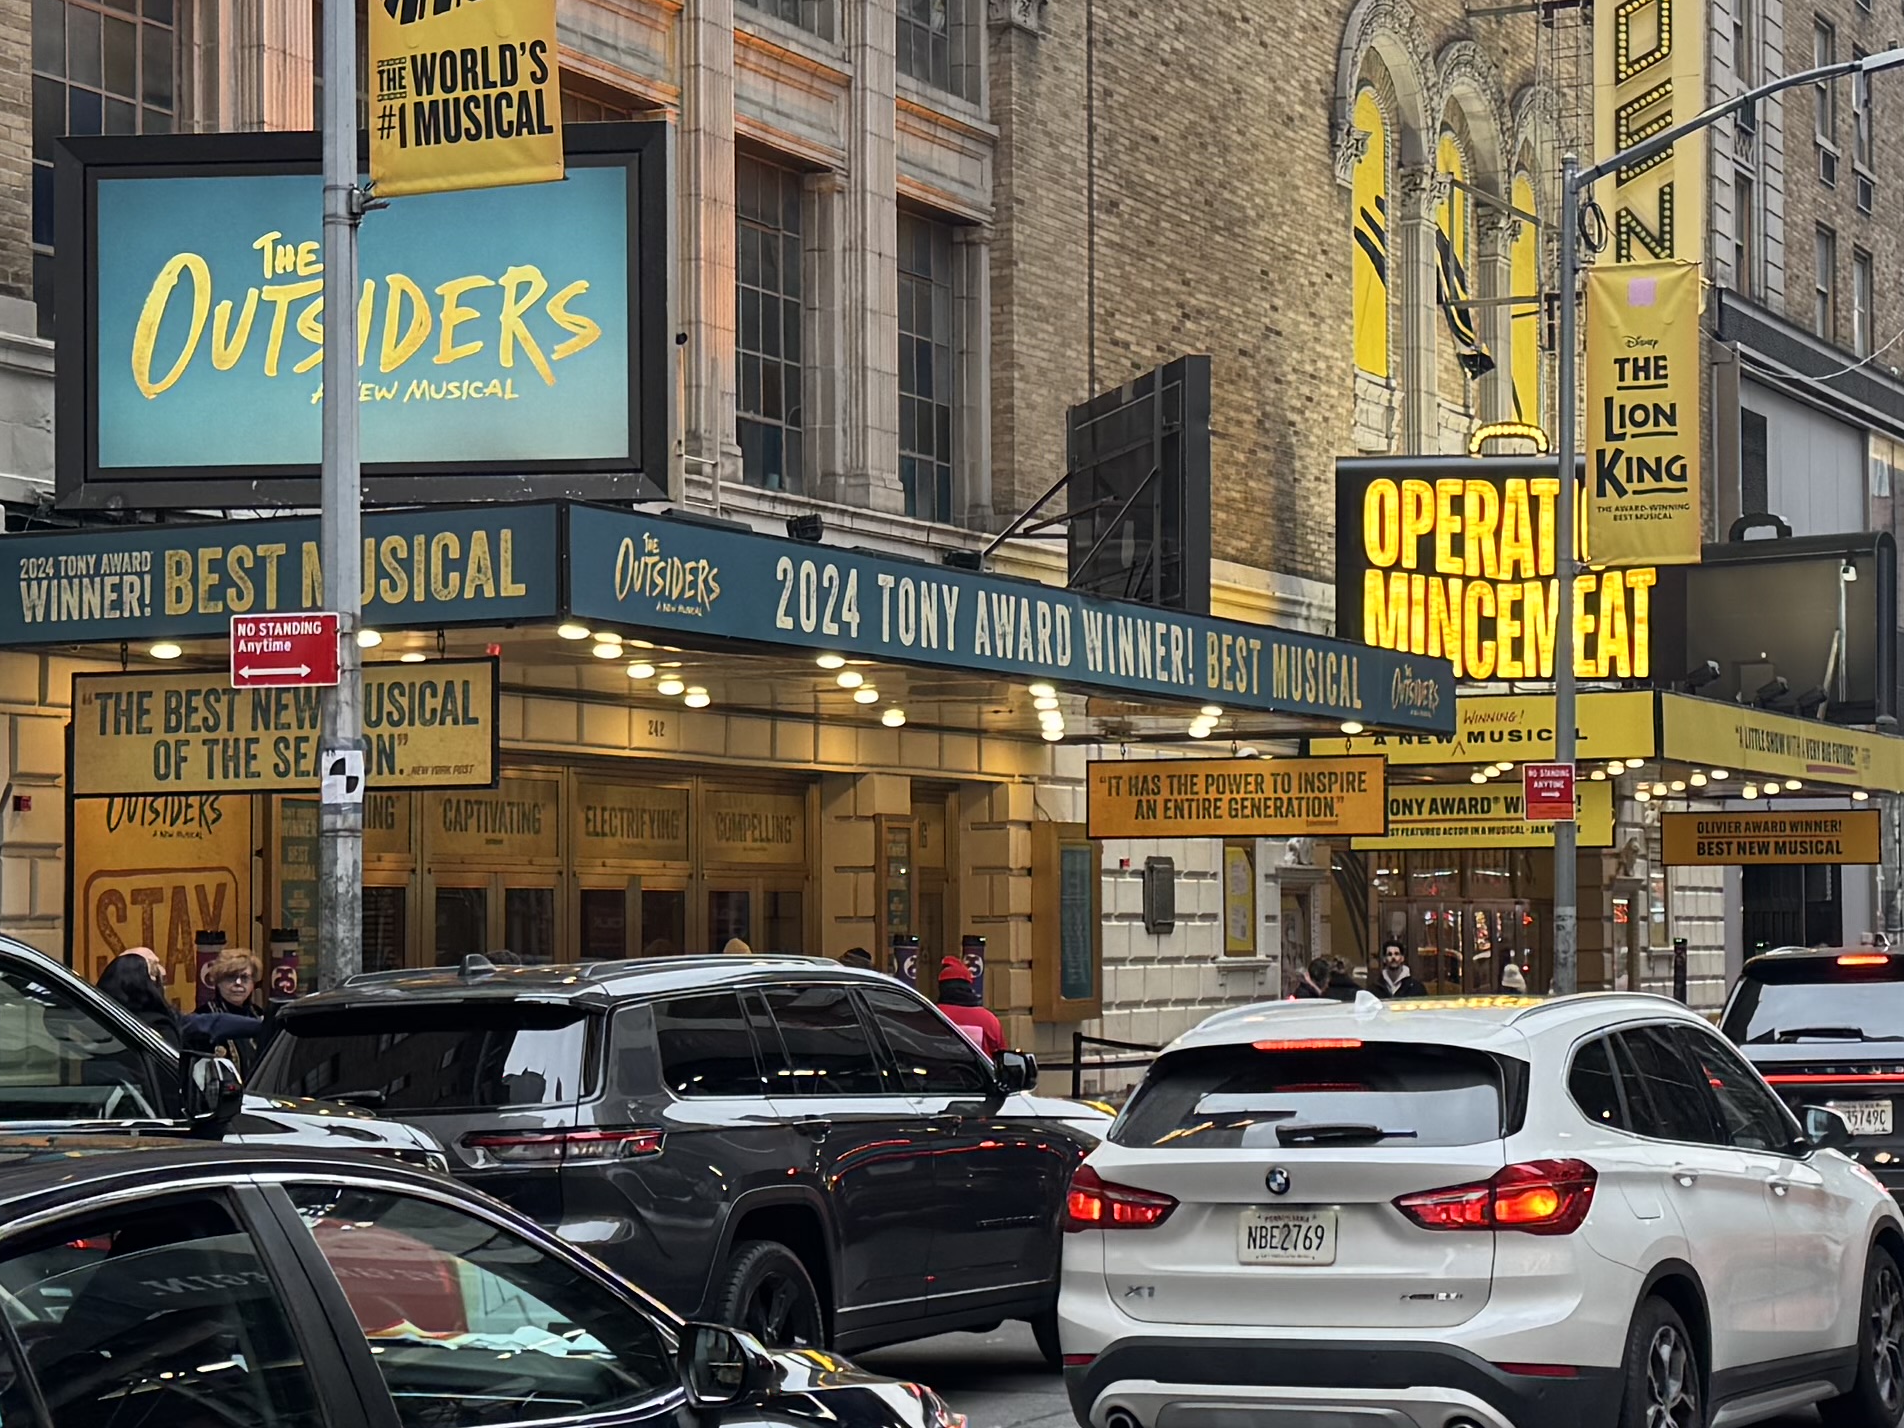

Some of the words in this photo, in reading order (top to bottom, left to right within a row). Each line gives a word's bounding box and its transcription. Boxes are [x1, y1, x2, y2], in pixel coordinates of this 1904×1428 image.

[377, 69, 407, 96] THE
[410, 39, 549, 97] WORLD’S
[377, 104, 408, 149] #1
[414, 88, 554, 147] MUSICAL
[253, 231, 324, 279] THE
[1613, 355, 1669, 383] THE
[357, 380, 398, 403] EW
[404, 378, 520, 404] MUSICAL
[1604, 396, 1678, 442] LION
[1596, 448, 1689, 499] KING
[1597, 505, 1613, 514] THE
[1614, 502, 1691, 513] AWARD-WINNING
[1613, 513, 1633, 522] BEST
[1634, 511, 1673, 522] MUSICAL
[643, 532, 660, 554] THE
[19, 556, 54, 580] 2024
[58, 554, 97, 577] TONY
[164, 542, 287, 616] BEST
[615, 537, 721, 612] OUTSIDERS
[20, 574, 152, 623] WINNER!
[237, 622, 257, 637] NO
[259, 621, 323, 636] STANDING
[775, 555, 861, 639] 2024
[877, 573, 958, 651] TONY
[1083, 608, 1195, 685] WINNER!
[1206, 630, 1263, 694] BEST
[1272, 643, 1363, 710] MUSICAL
[238, 639, 292, 656] Anytime
[164, 688, 242, 734] BEST
[252, 687, 322, 731] NEW
[364, 680, 480, 730] USICAL
[1464, 709, 1525, 725] WINNING!
[1467, 728, 1589, 744] MUSICL
[1746, 726, 1765, 753] LITTLE
[1766, 730, 1786, 756] SHOW
[1805, 737, 1821, 763] VERY
[1821, 740, 1832, 764] BIG
[153, 739, 190, 782] OF
[202, 736, 262, 781] THE
[1128, 775, 1161, 797] HAS
[1166, 774, 1199, 796] THE
[1205, 772, 1265, 795] POWER
[1270, 772, 1292, 794] TO
[1298, 771, 1368, 794] INSPIRE
[1134, 798, 1158, 821] AN
[1163, 797, 1222, 820] ENTIRE
[1389, 798, 1427, 817] ONY
[1390, 826, 1400, 837] ST
[1400, 826, 1441, 837] FEATURED
[1442, 826, 1469, 837] ACTOR
[1486, 825, 1526, 836] MUSICAL
[1697, 820, 1742, 835] OLIVIER
[1744, 820, 1787, 834] AWARD
[1789, 819, 1842, 834] WINNER!
[1697, 841, 1733, 856] BEST
[1737, 840, 1771, 856] NEW
[1775, 840, 1844, 856] MUSICAL
[1247, 1223, 1326, 1252] NBE2769
